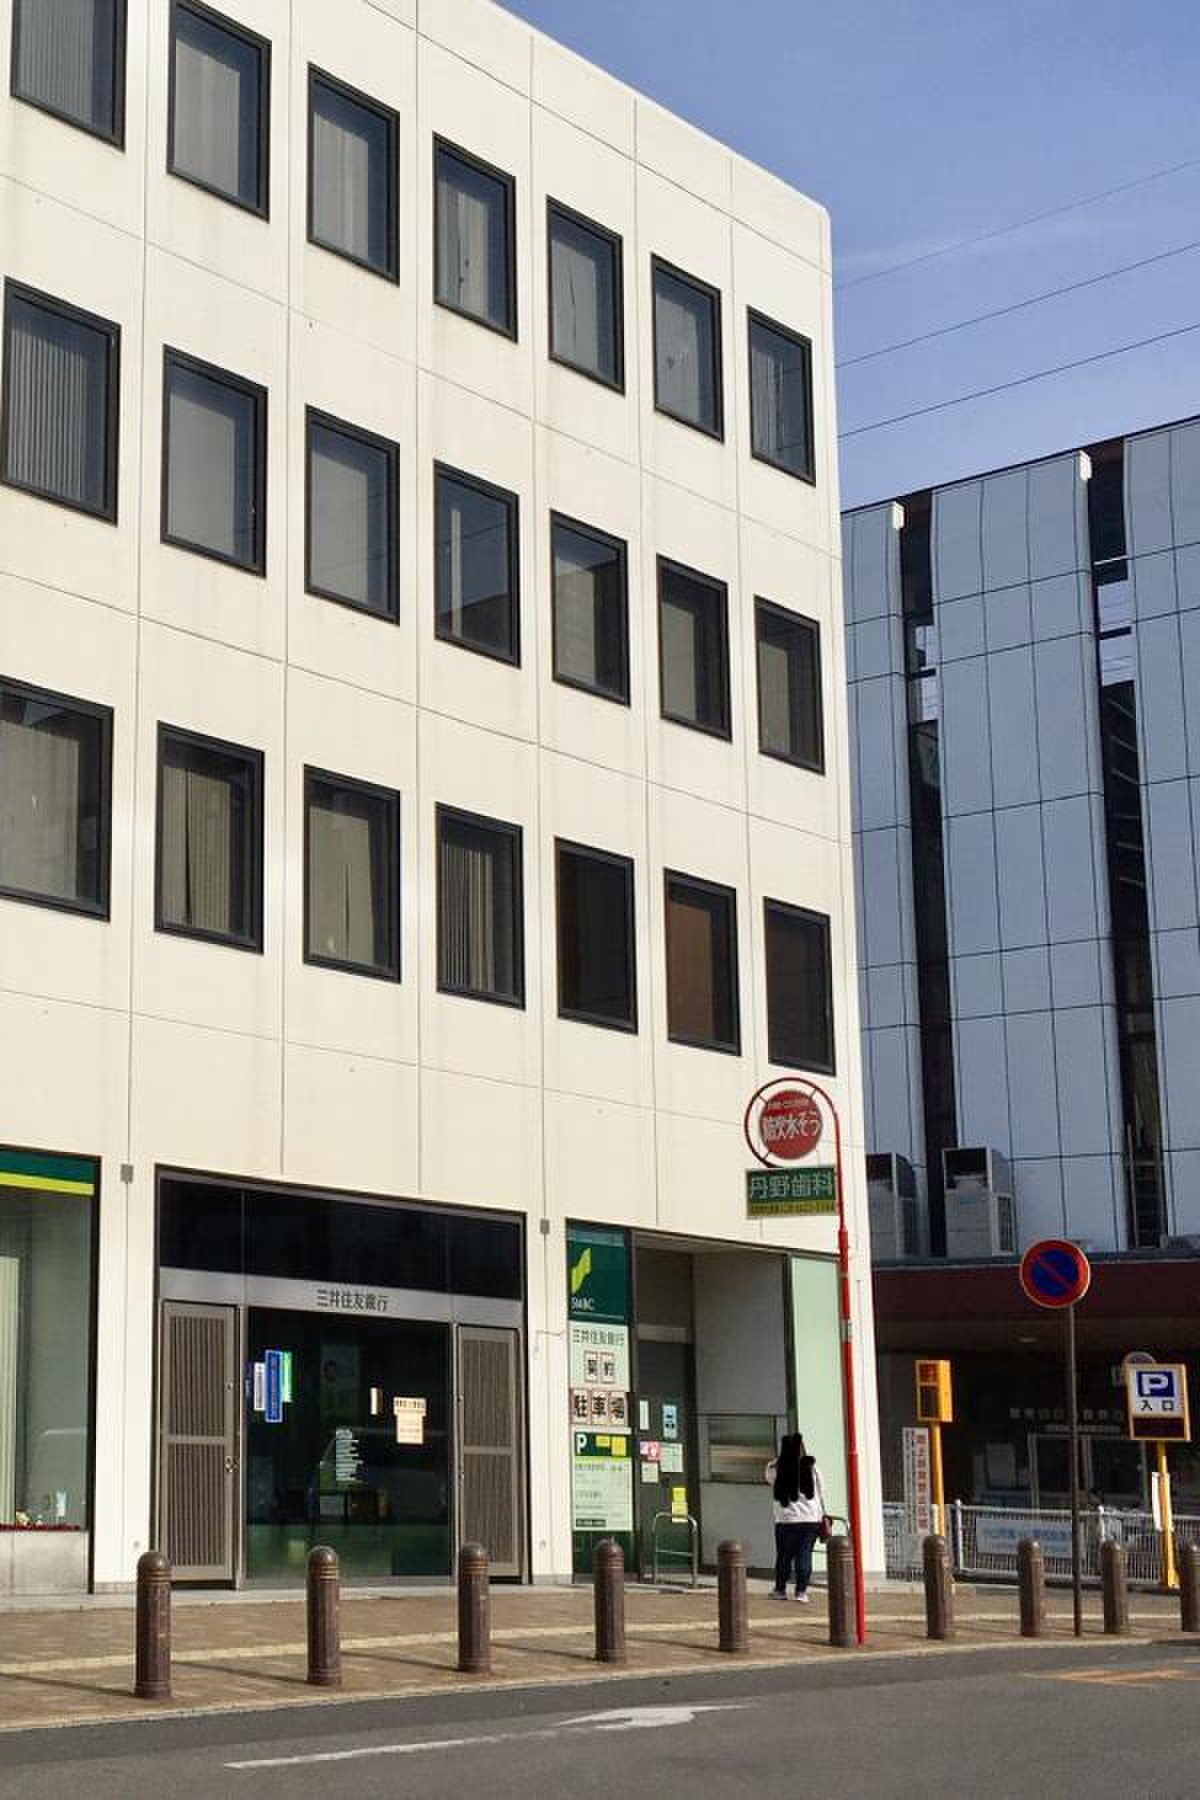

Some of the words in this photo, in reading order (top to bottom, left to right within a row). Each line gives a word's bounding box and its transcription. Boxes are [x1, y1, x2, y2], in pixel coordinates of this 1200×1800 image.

[316, 1289, 389, 1312] 三井住友銀行
[1141, 1373, 1169, 1395] P
[1140, 1399, 1175, 1412] 入口
[575, 1433, 588, 1455] P
